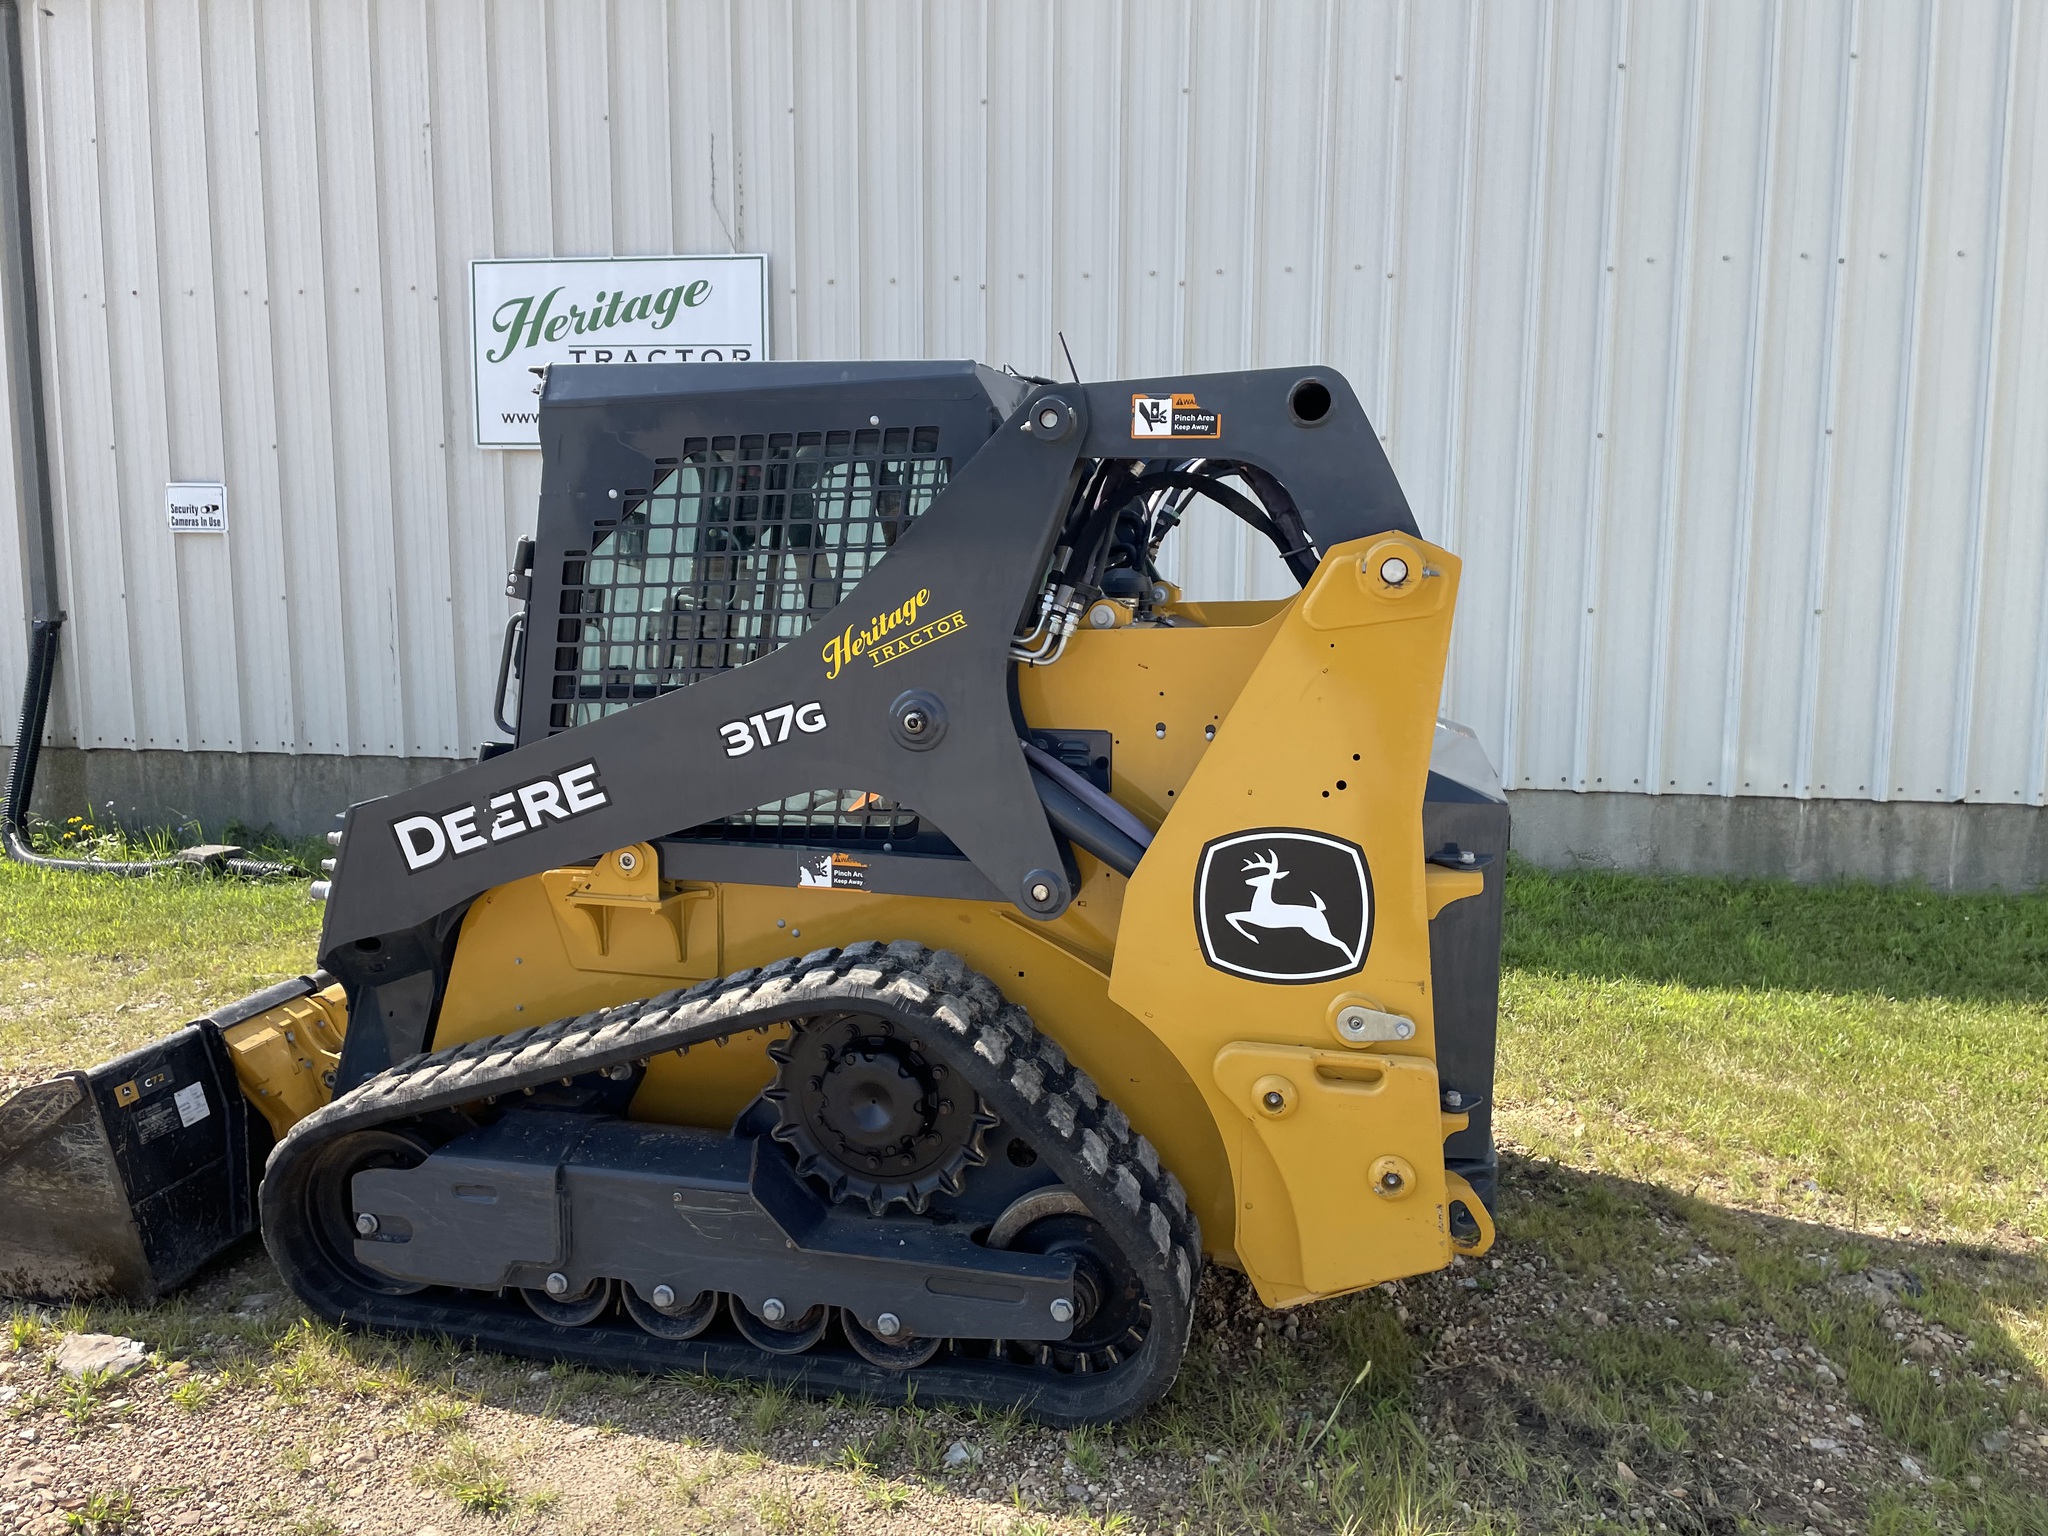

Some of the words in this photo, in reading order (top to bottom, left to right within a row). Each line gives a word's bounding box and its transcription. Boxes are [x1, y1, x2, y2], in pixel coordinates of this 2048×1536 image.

[486, 279, 713, 363] Heritage
[170, 503, 199, 516] Security
[171, 516, 199, 527] Cameras
[200, 516, 207, 526] In
[208, 516, 221, 527] Use
[822, 588, 930, 680] Heritage
[868, 613, 966, 664] TRACTOR
[719, 702, 827, 757] 317G
[393, 763, 608, 870] DEERE
[833, 869, 852, 877] Pinch
[144, 1073, 165, 1088] C72
